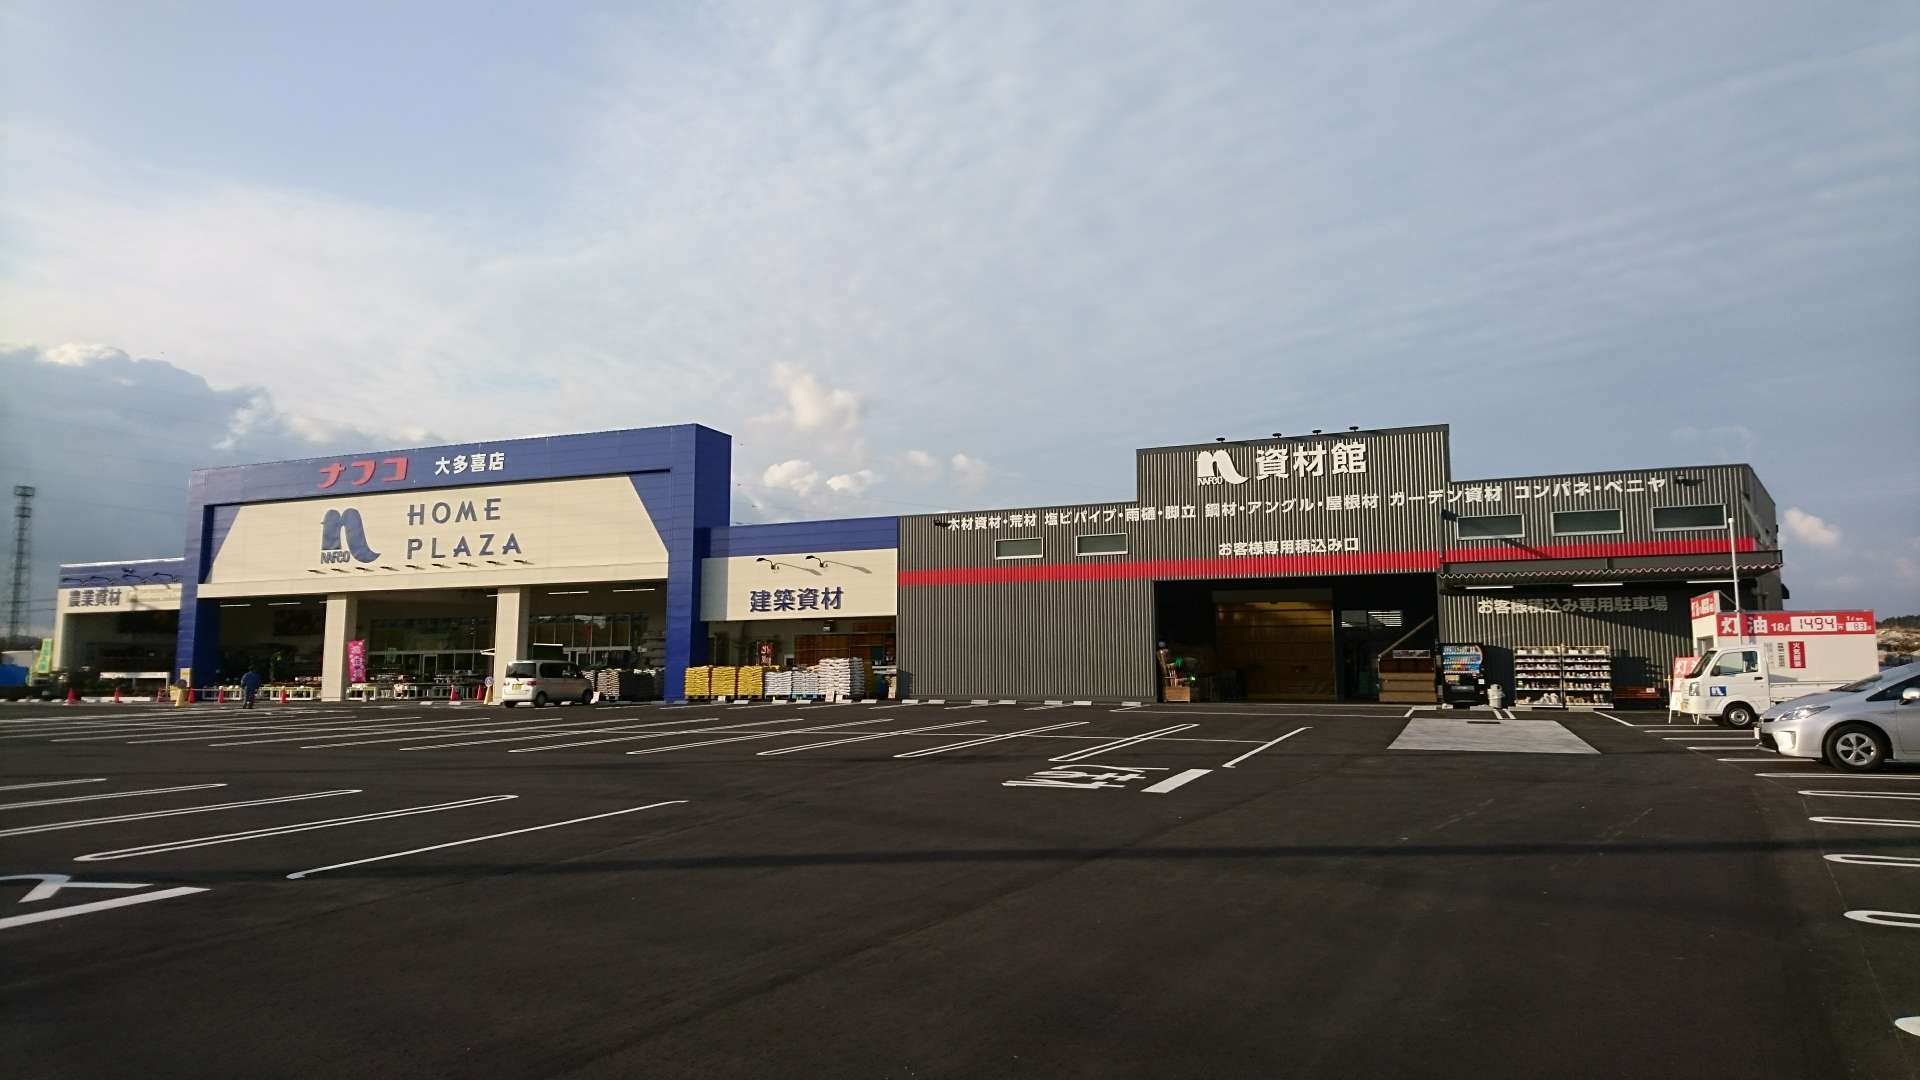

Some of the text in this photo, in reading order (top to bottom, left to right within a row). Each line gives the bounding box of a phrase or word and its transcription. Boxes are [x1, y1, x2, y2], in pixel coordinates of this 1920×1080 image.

[319, 452, 505, 489] ナフコ 大多喜店
[1256, 441, 1367, 480] 資材館
[1390, 484, 1502, 507] ガーデン資材
[1514, 477, 1666, 499] コンパネ・ベニヤ
[407, 498, 501, 526] HOME
[407, 533, 521, 560] PLAZA
[68, 589, 122, 607] 農業資材
[750, 586, 844, 612] 建築資材
[1721, 616, 1768, 633] 灯油
